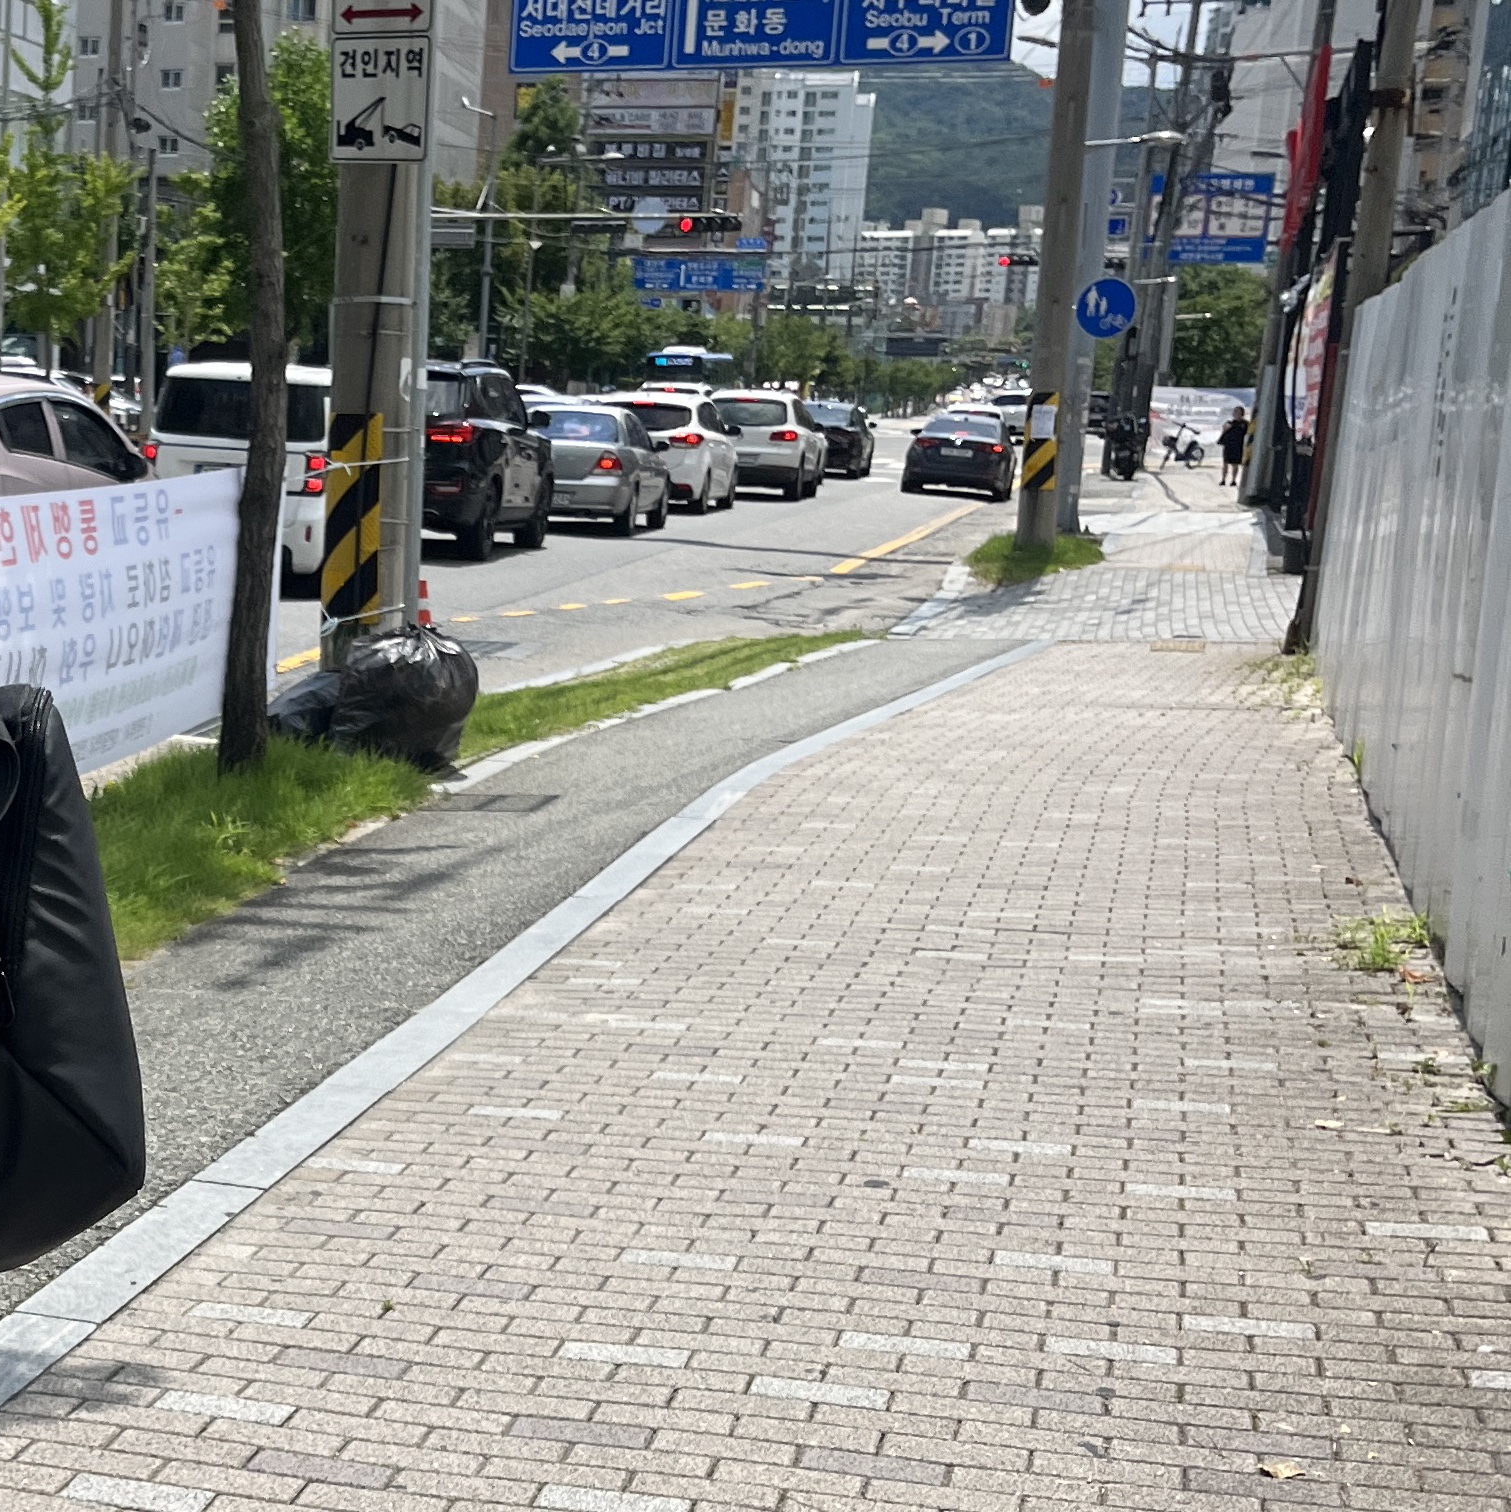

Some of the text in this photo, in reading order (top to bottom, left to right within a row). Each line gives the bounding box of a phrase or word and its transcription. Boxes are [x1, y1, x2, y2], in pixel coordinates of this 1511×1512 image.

[519, 18, 664, 40] Seodaejeon Jct
[703, 8, 787, 36] 문화동
[865, 8, 991, 28] Seobu Term
[701, 38, 825, 59] Munhwa-dong
[340, 47, 424, 79] 견인지역
